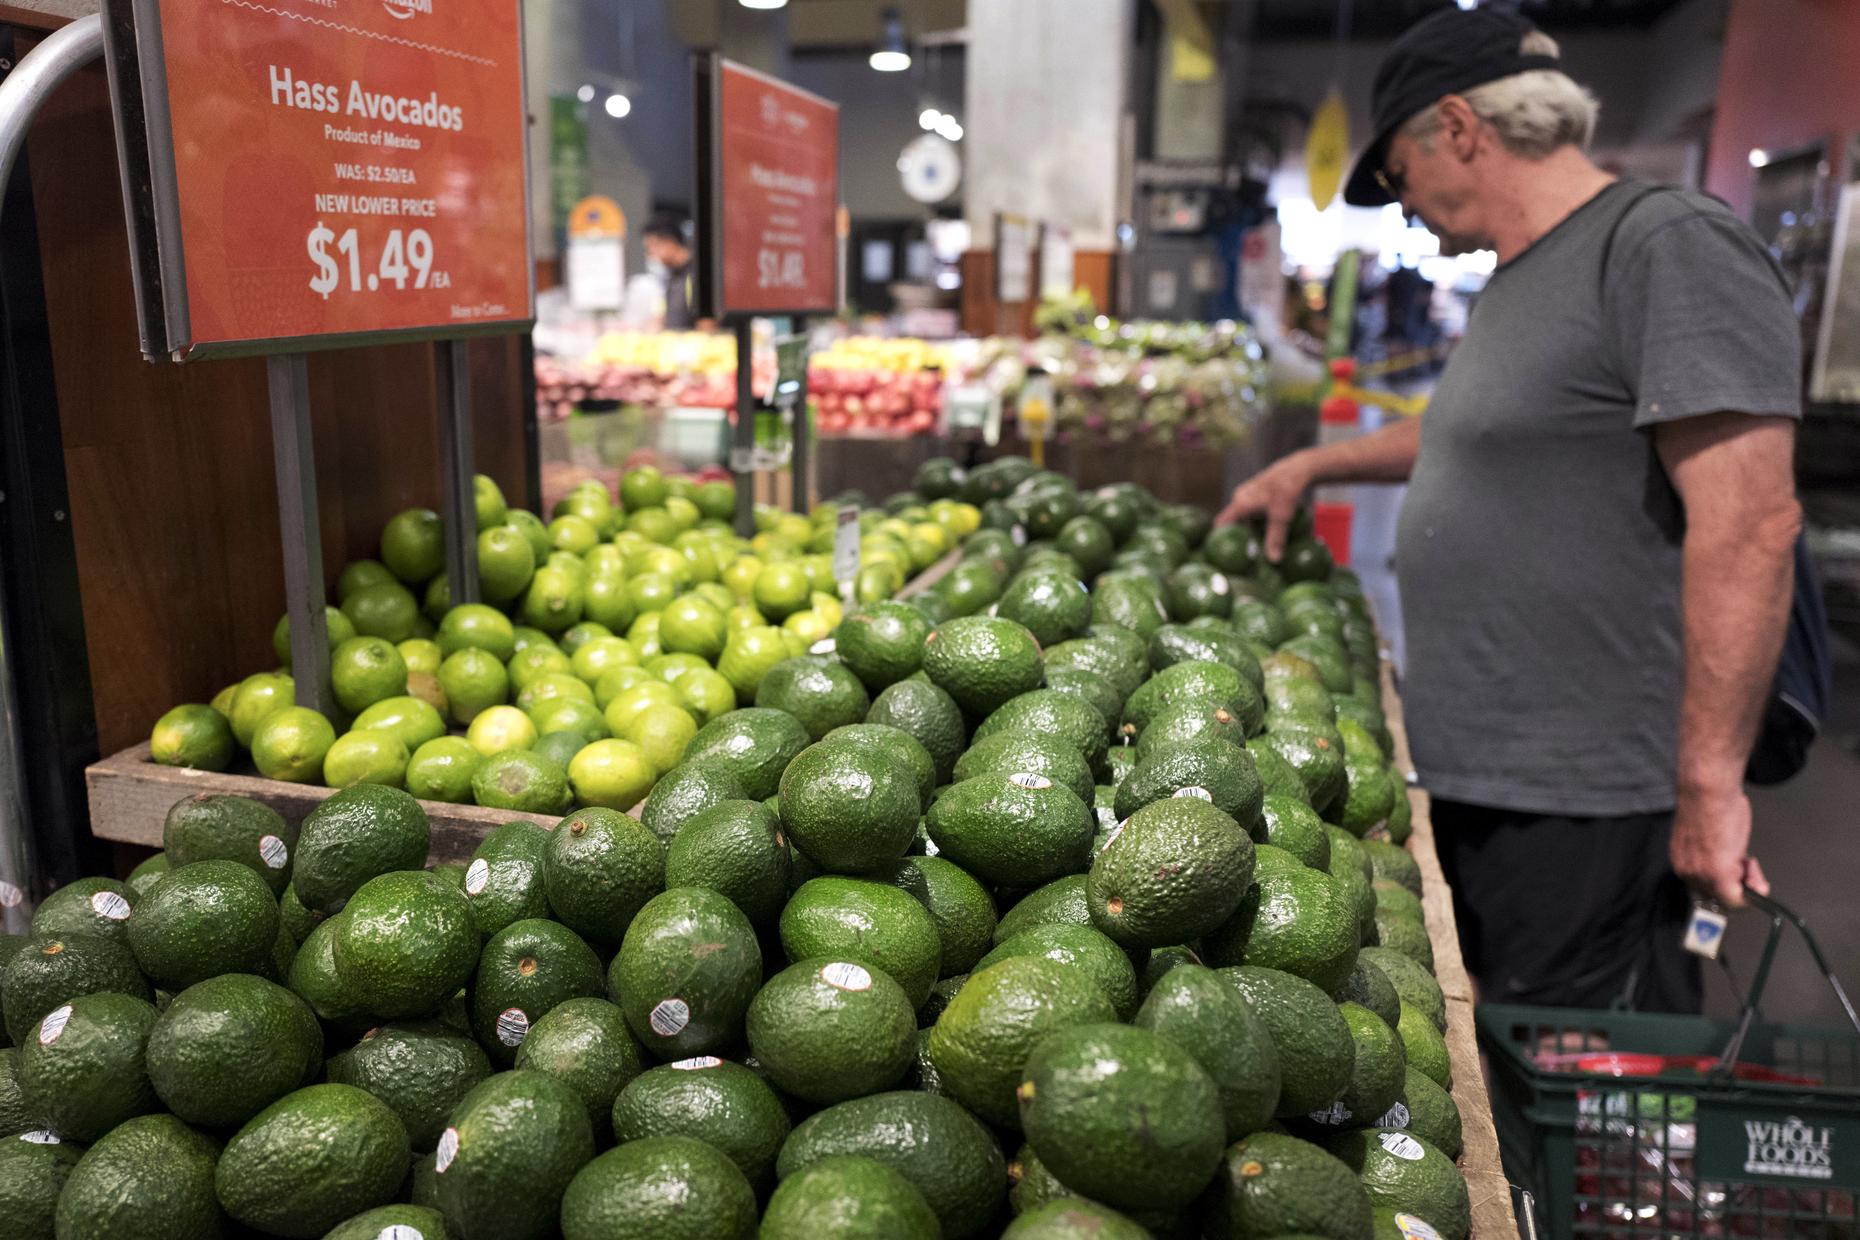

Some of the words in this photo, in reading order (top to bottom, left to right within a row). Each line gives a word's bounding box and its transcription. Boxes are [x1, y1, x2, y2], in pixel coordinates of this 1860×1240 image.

[269, 65, 340, 113] Hass
[346, 80, 463, 132] Avocados
[324, 124, 369, 145] Product
[370, 130, 382, 145] of
[384, 131, 421, 150] Mexico
[334, 163, 365, 181] WAS:
[315, 193, 349, 213] NEW
[351, 195, 399, 215] LOWER
[401, 198, 437, 217] PRICE
[1747, 1142, 1832, 1168] FOODS
